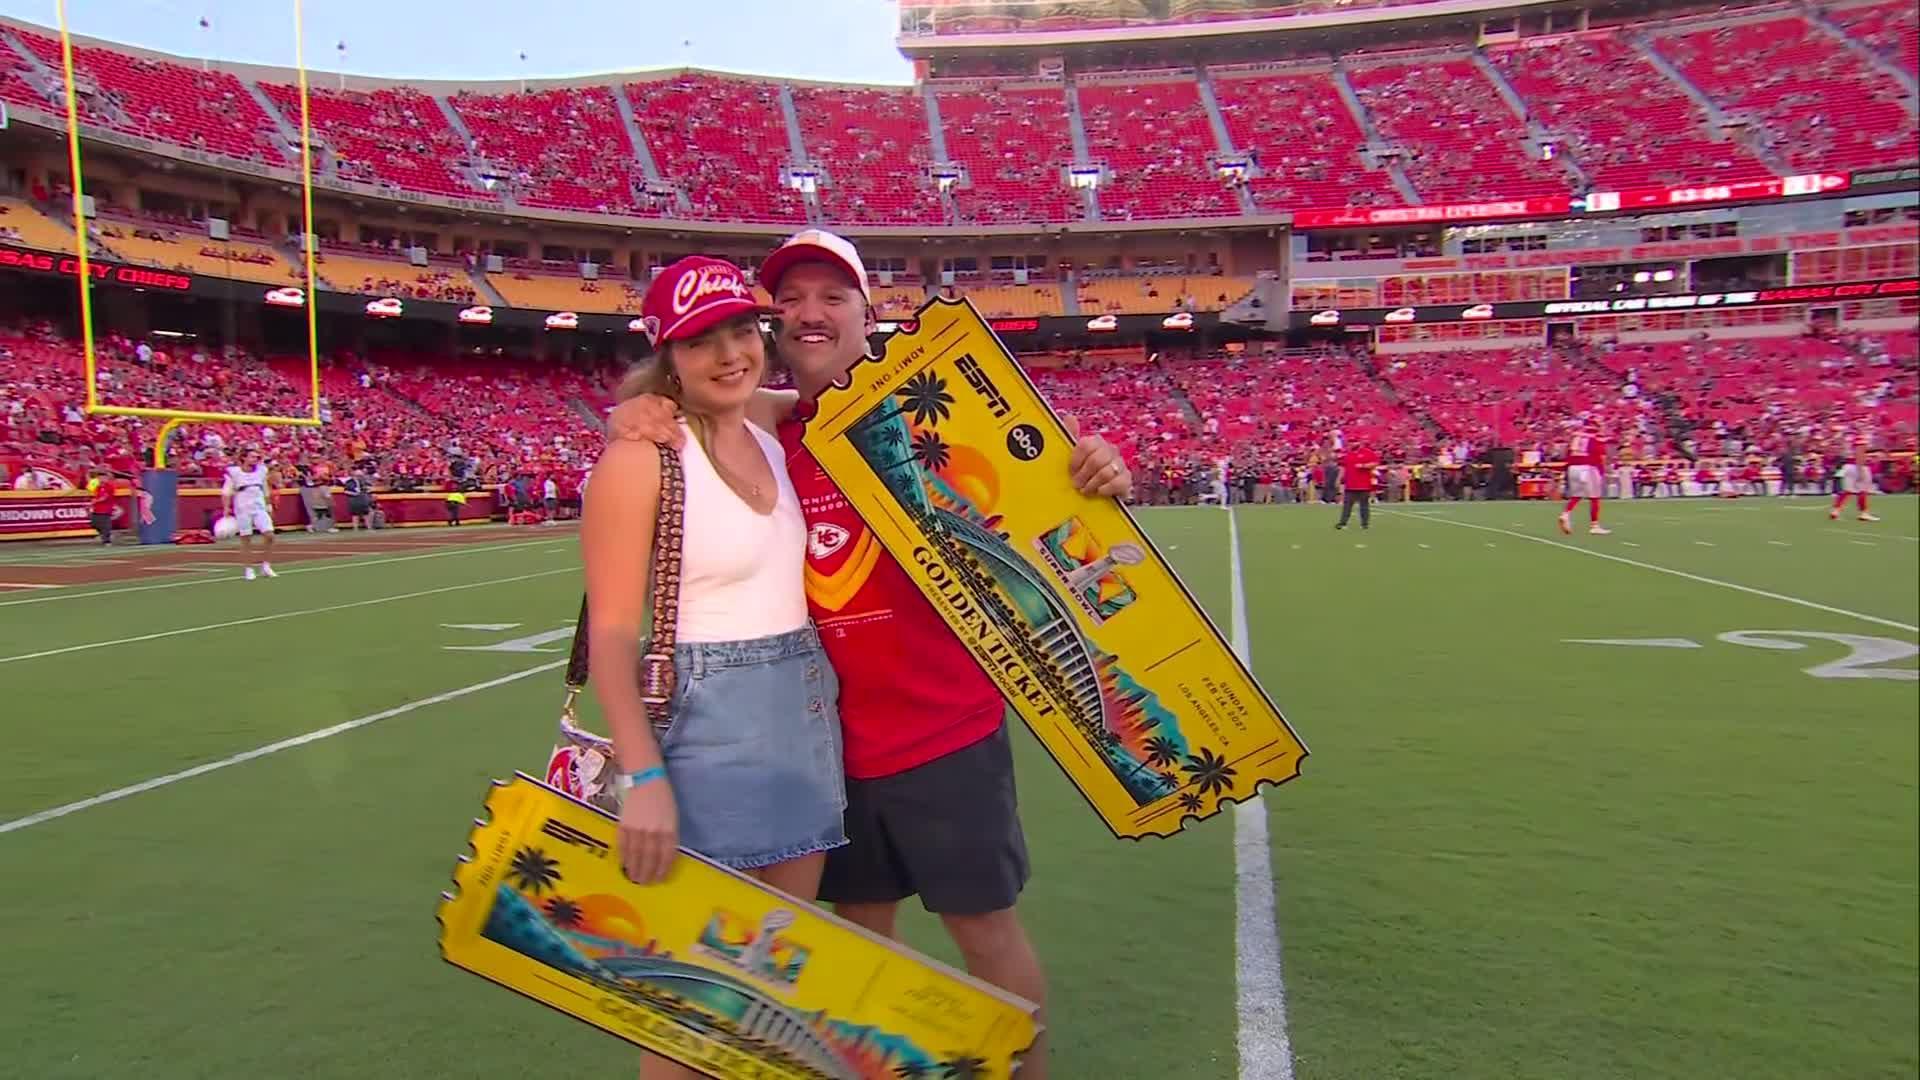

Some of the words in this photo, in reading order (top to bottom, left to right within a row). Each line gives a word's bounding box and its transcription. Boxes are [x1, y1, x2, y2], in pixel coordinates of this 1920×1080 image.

[116, 267, 192, 290] CHIEFS
[893, 345, 926, 374] ADMIT
[871, 374, 891, 393] ONE
[952, 352, 1012, 419] ESPN
[1011, 427, 1039, 458] abc
[55, 507, 88, 519] CLUB
[1039, 547, 1070, 584] SUPER
[1069, 585, 1097, 618] BOWL
[912, 545, 993, 641] GOLDEN
[987, 637, 1057, 718] TICKET
[1201, 676, 1219, 695] FEB
[1219, 681, 1248, 716] SUNDAY
[1177, 682, 1193, 699] LOS
[1219, 734, 1230, 747] CA
